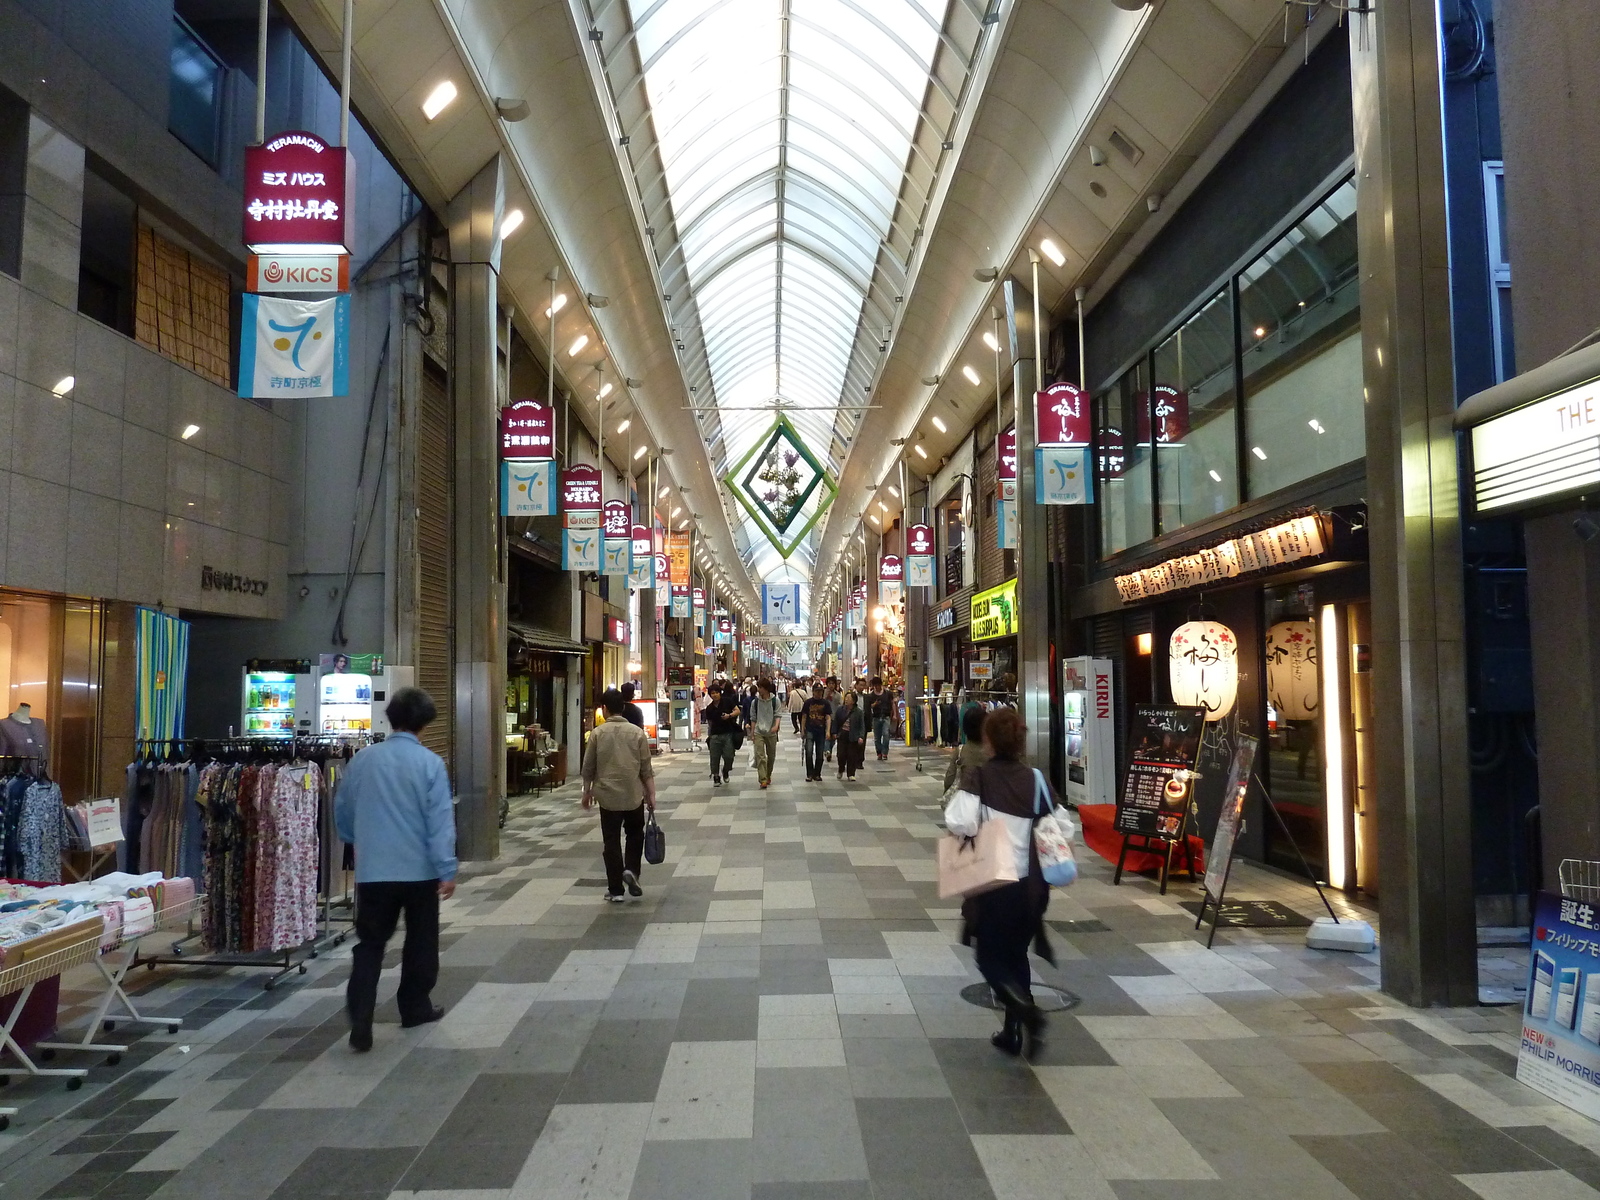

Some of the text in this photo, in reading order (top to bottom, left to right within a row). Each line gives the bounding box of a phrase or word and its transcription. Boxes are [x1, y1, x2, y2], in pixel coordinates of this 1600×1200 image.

[267, 136, 325, 154] TERAMACHI
[262, 172, 326, 186] ミズ ハウス
[247, 199, 339, 221] 寺村牡丹堂
[286, 267, 333, 283] KICS
[270, 375, 322, 389] 寺町京極
[1557, 397, 1596, 432] THE
[579, 517, 597, 525] KICS
[1096, 674, 1109, 718] KIRIN
[1560, 899, 1600, 930] 誕生。
[1547, 928, 1600, 957] フィリップモ
[1523, 1027, 1545, 1044] NEW
[1521, 1039, 1555, 1062] PHILIP
[1556, 1055, 1600, 1085] MORRIS
